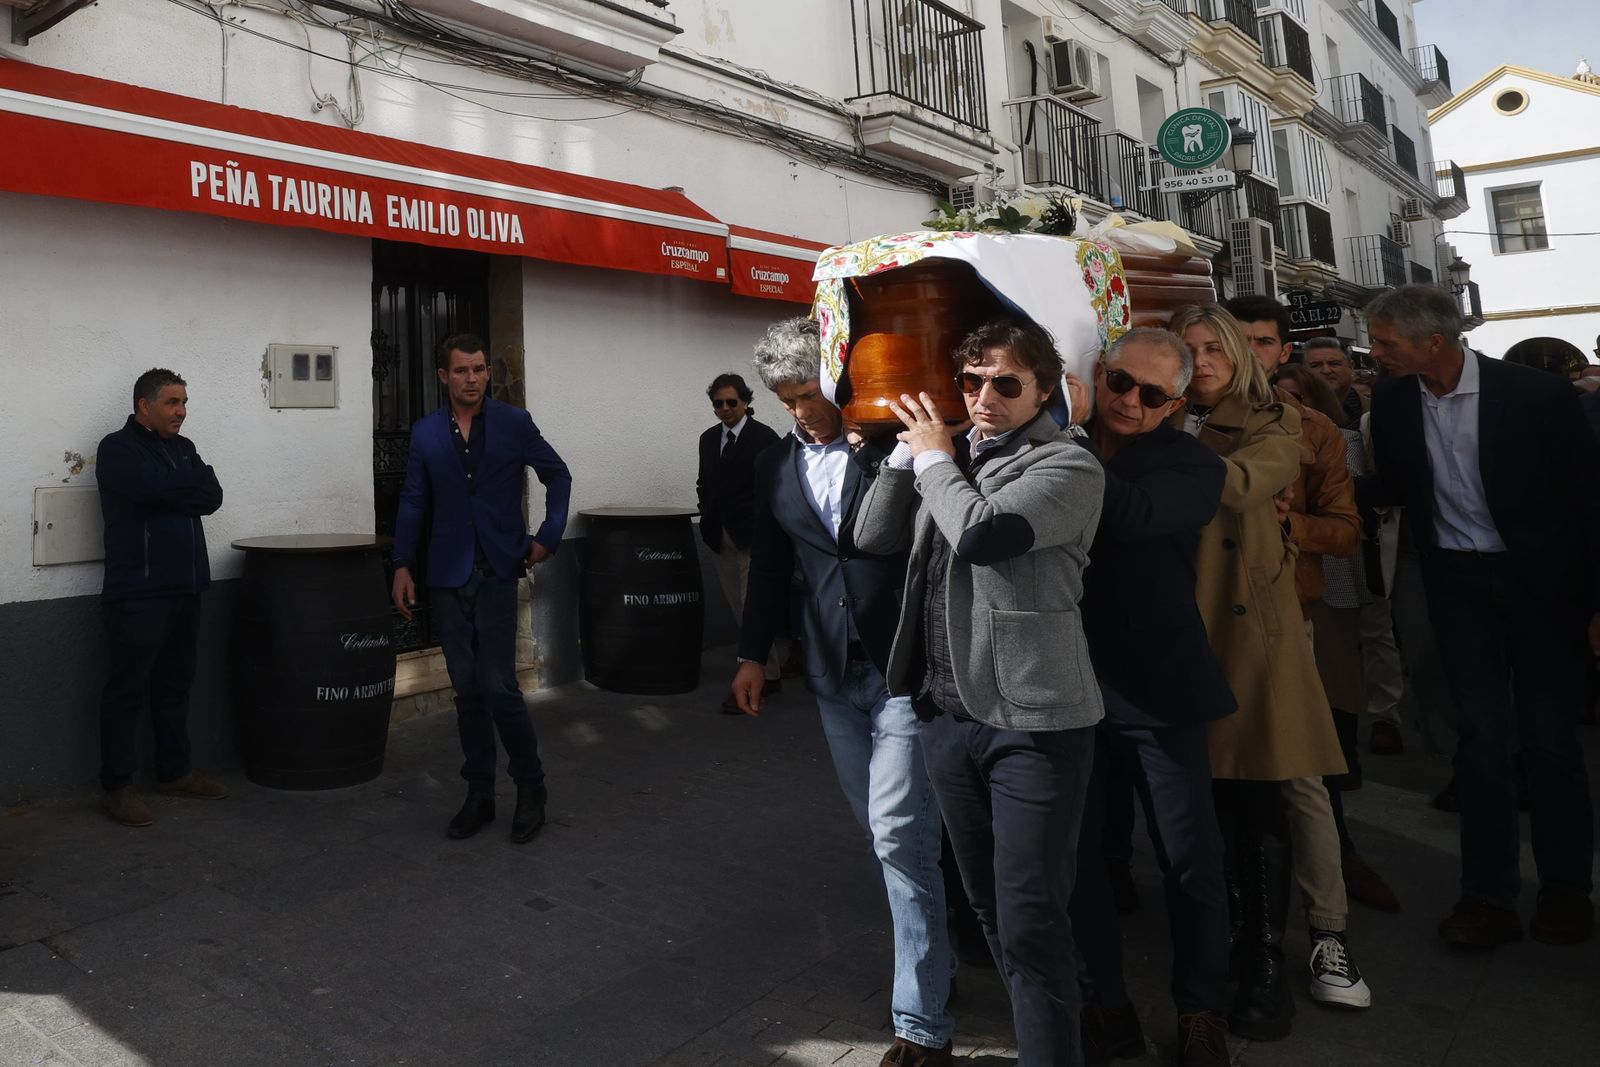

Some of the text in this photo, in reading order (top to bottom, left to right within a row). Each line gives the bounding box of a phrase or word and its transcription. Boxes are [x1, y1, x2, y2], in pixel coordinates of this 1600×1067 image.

[1192, 115, 1217, 129] DENTAL
[1173, 146, 1215, 161] PADRE CARO
[1164, 174, 1229, 189] 956 40 53 01
[190, 160, 525, 244] PEÑA TAURINA EMILIO OLIVA
[661, 241, 709, 263] Cruzcampo
[751, 266, 790, 285] Cruzcampo
[760, 283, 784, 294] ESPECIAL
[1309, 309, 1325, 321] EL
[1326, 307, 1339, 320] 22
[623, 594, 649, 606] FINO
[316, 686, 349, 701] FINO
